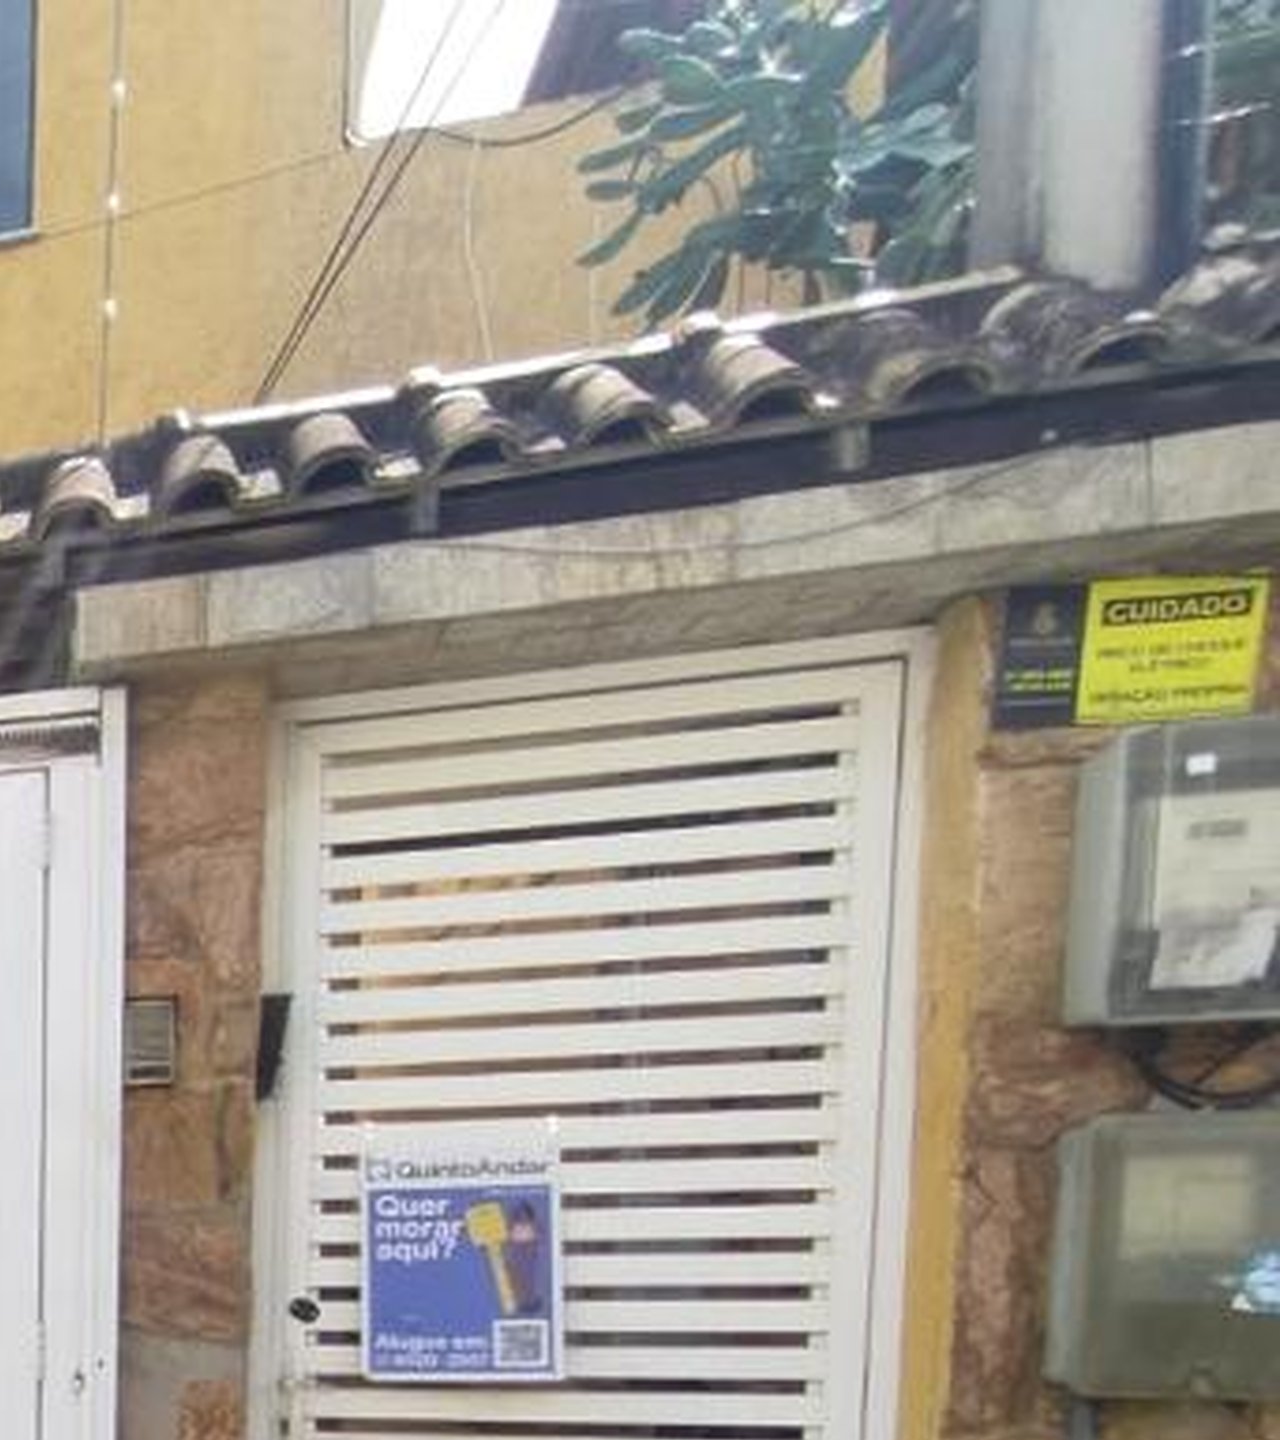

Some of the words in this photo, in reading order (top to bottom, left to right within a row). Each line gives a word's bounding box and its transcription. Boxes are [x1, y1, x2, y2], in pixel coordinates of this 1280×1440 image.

[1107, 594, 1246, 623] CUIDADO
[375, 1196, 449, 1217] Quer
[375, 1221, 466, 1239] morar
[375, 1239, 457, 1265] aqui?
